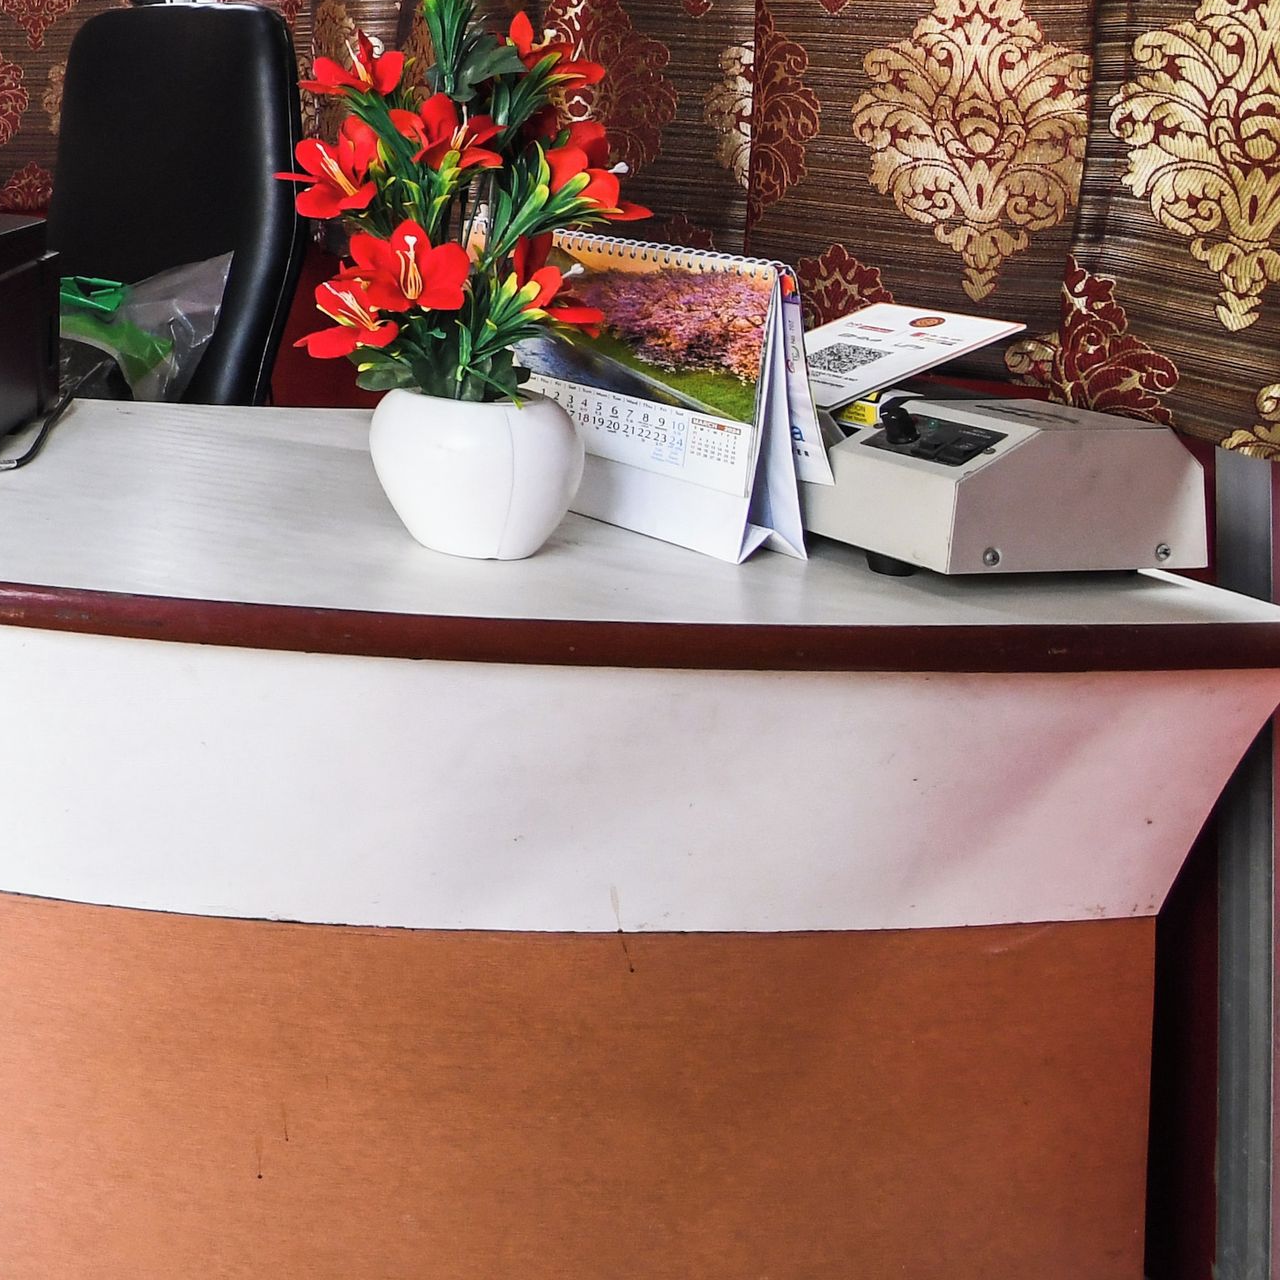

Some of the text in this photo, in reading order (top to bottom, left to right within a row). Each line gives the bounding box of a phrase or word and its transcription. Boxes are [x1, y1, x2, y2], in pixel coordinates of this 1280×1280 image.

[553, 391, 560, 401] 2
[568, 394, 574, 404] 3
[580, 398, 588, 407] 4
[596, 401, 603, 411] 5
[611, 405, 619, 415] 6
[627, 409, 634, 418] 7
[642, 413, 650, 423] 8
[658, 417, 666, 427] 9
[671, 420, 686, 431] 10
[577, 412, 590, 423] 18
[592, 416, 605, 427] 19
[606, 420, 620, 431] 20
[622, 424, 635, 435] 21
[637, 428, 652, 439] 22
[653, 432, 667, 443] 23
[669, 436, 683, 447] 24
